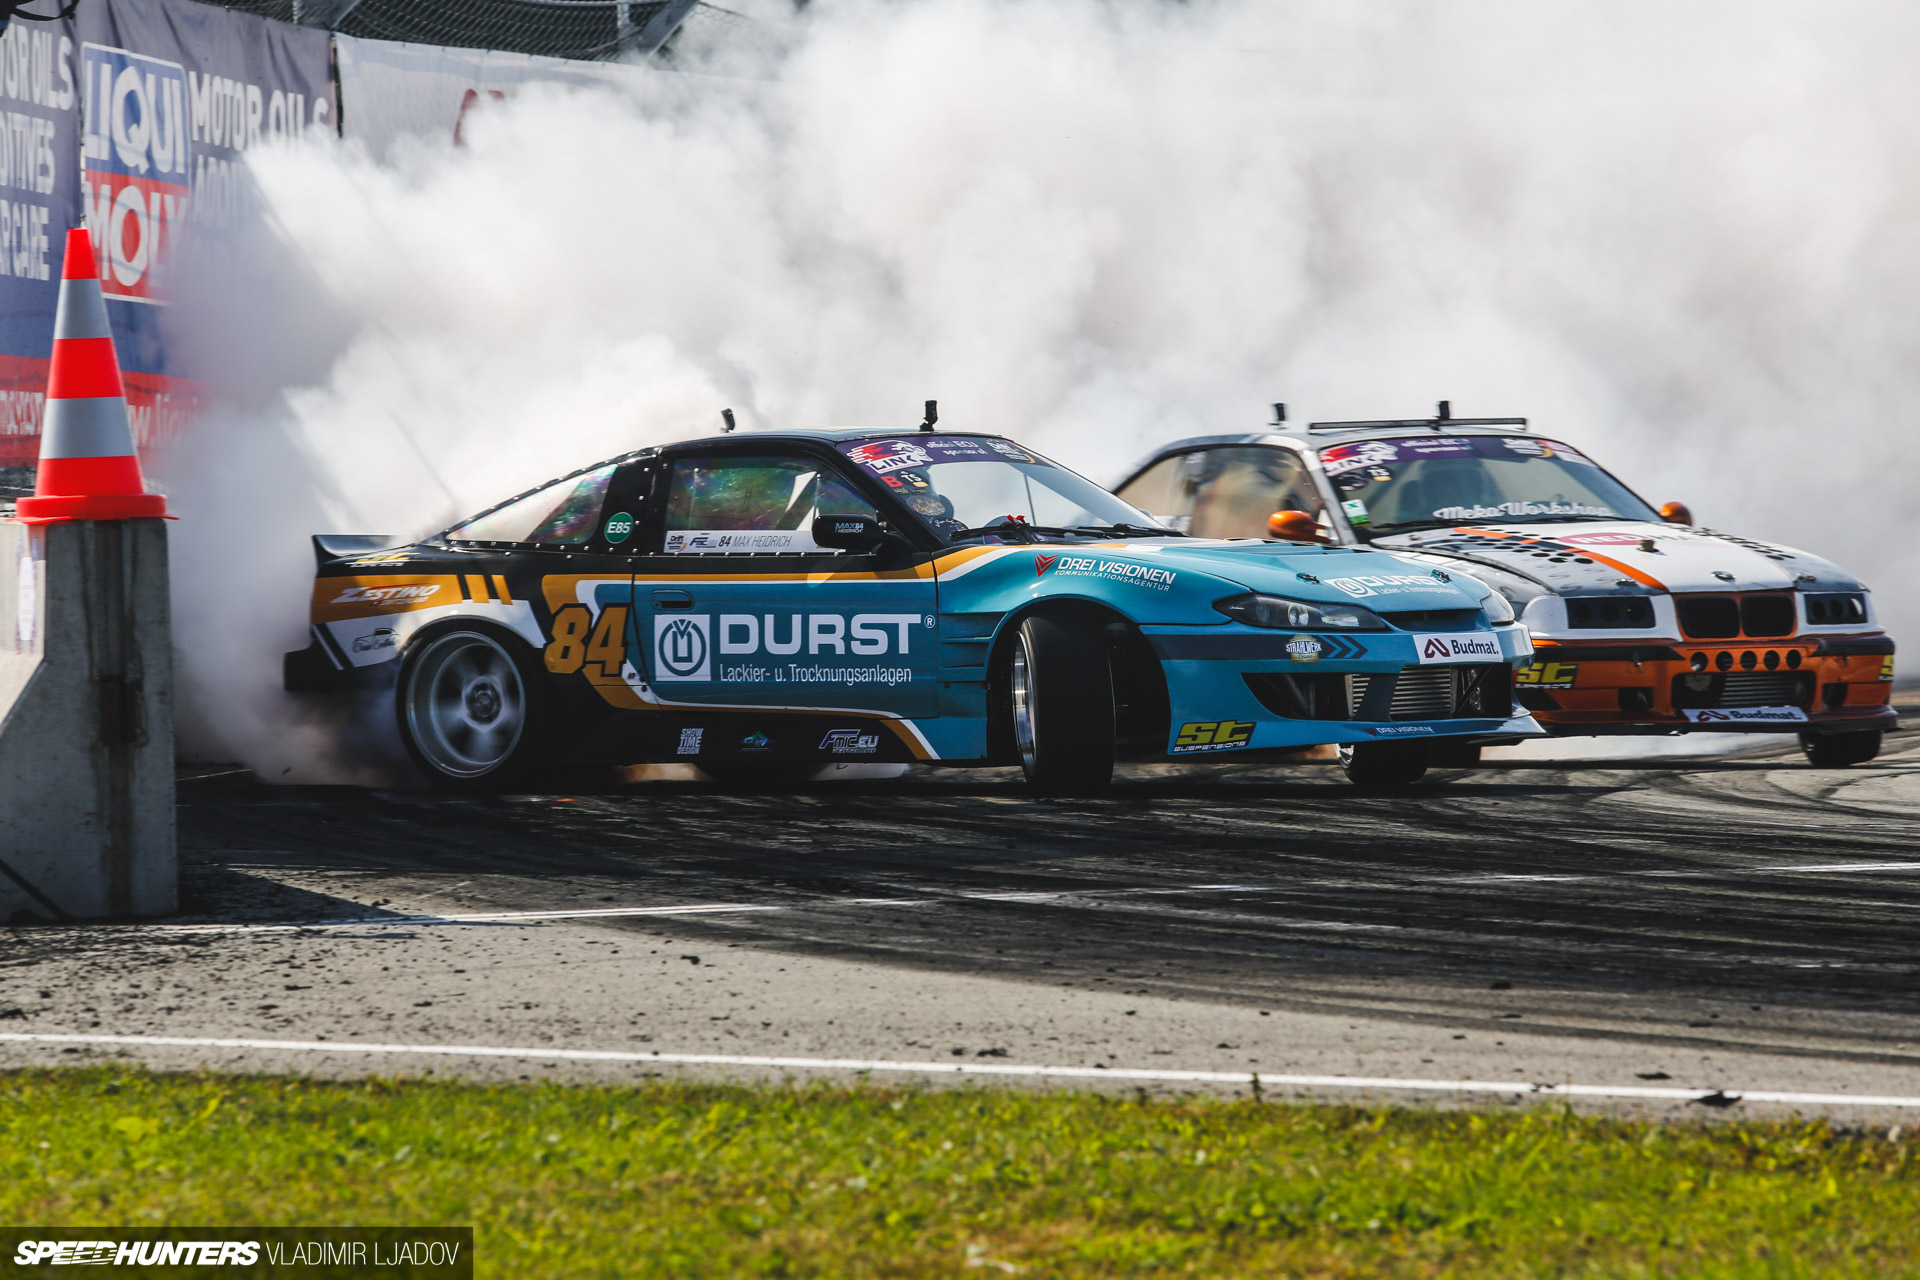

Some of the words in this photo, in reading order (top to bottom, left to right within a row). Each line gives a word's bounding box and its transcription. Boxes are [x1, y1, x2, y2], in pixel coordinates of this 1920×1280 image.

[84, 60, 185, 175] LIQUI
[189, 70, 263, 151] MOTOR
[83, 180, 189, 289] MOLY
[871, 455, 916, 471] LINK
[606, 521, 632, 534] E85
[718, 535, 733, 548] 84
[732, 535, 750, 548] MAX
[752, 535, 792, 548] HEIDRICH
[1053, 569, 1171, 592] KOMMUNIKATIONSAGENTUR
[1057, 556, 1097, 571] DREI
[1098, 560, 1177, 585] VISIONEN
[329, 584, 442, 604] ZESTINO
[544, 604, 630, 676] 84
[719, 613, 922, 655] DURST
[1286, 641, 1322, 654] STRAHLWERK
[719, 663, 771, 683] Lackier-
[774, 667, 787, 683] u.
[788, 664, 912, 686] Trocknungsanlagen
[679, 737, 702, 747] TIME
[680, 728, 704, 738] SHOW
[676, 747, 699, 755] DESIGN
